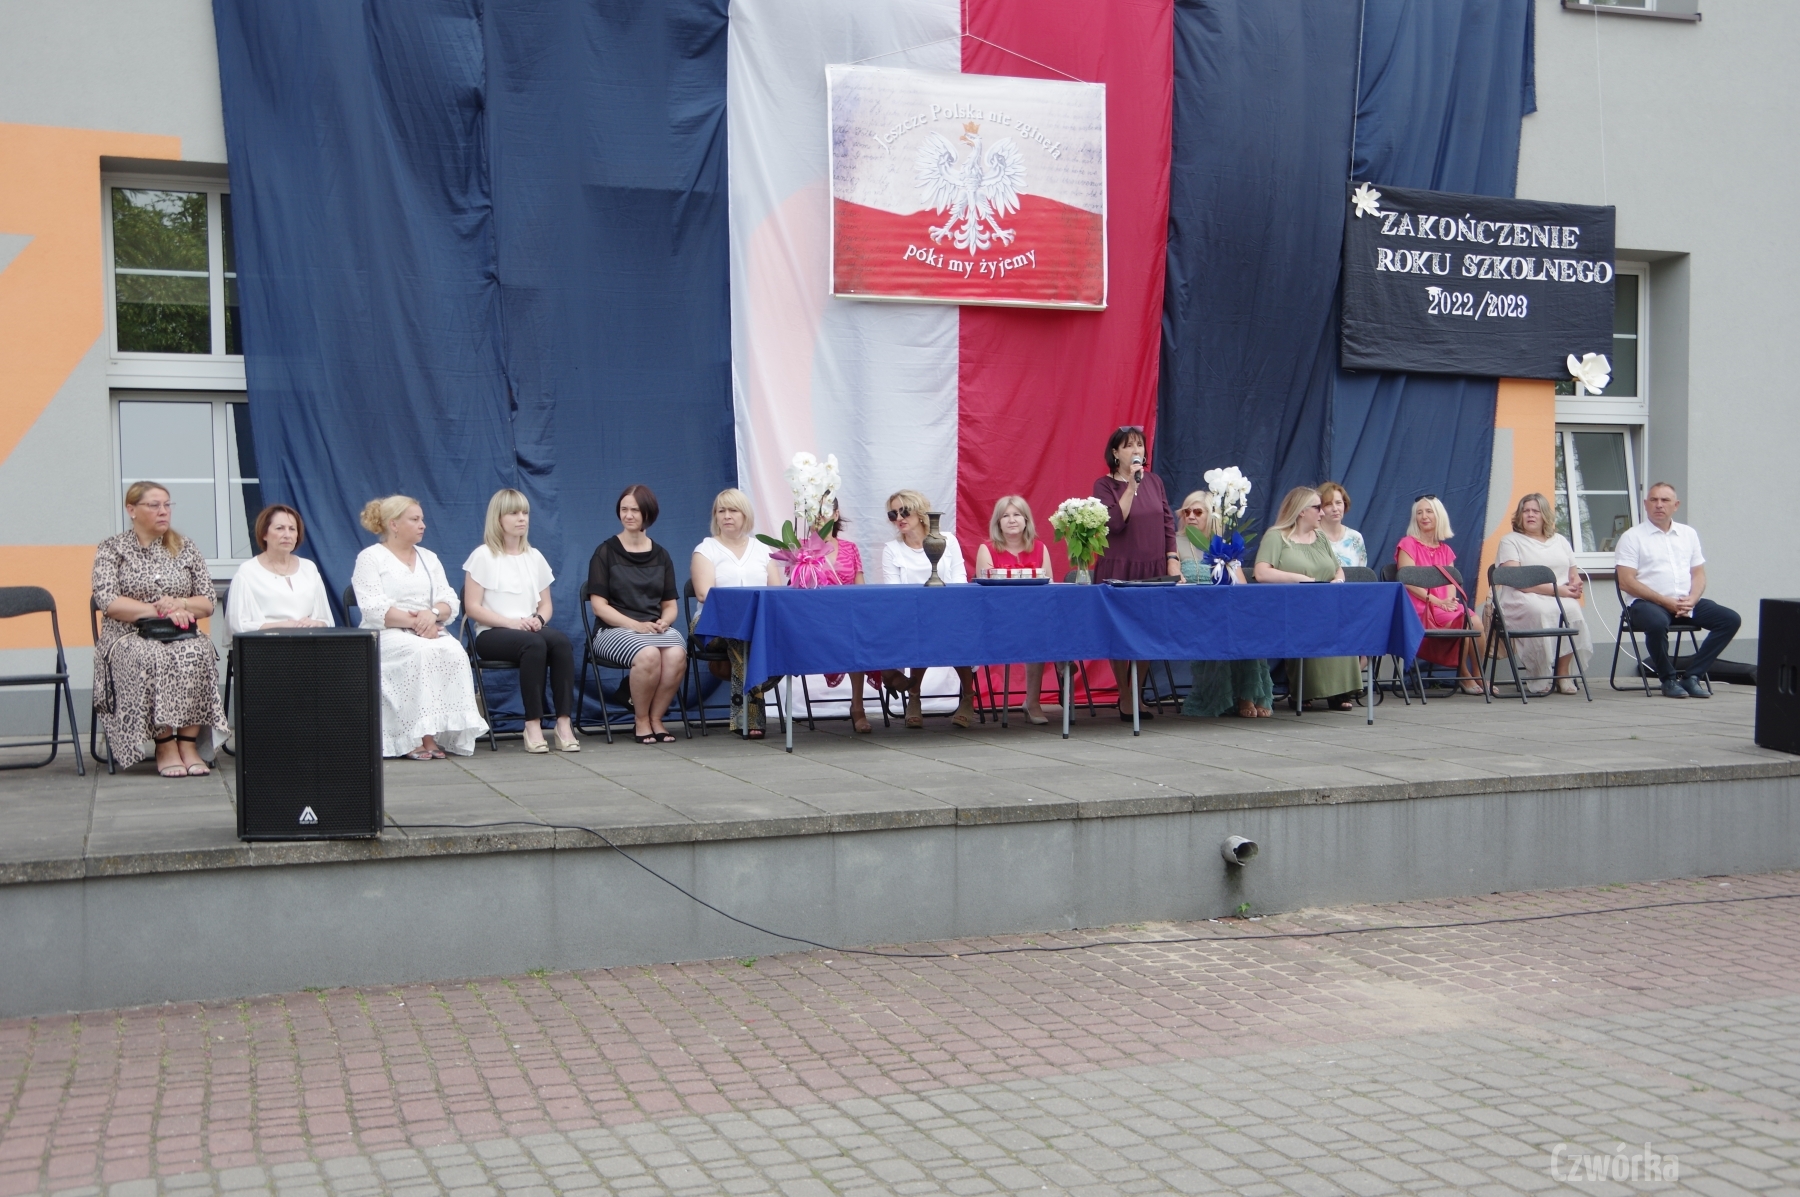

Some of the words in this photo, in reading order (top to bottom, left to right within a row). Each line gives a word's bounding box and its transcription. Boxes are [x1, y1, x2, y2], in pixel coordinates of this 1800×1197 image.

[873, 112, 928, 154] Jeszcze
[930, 103, 984, 121] Polska
[989, 108, 1012, 126] nie
[1014, 120, 1062, 160] zginęła
[1380, 210, 1580, 250] ZAKOŃCZENIE
[903, 244, 944, 268] póki
[947, 258, 974, 279] my
[979, 249, 1036, 279] żyjemy
[1376, 247, 1451, 275] ROKU
[1462, 253, 1613, 284] SZKOLNEGO
